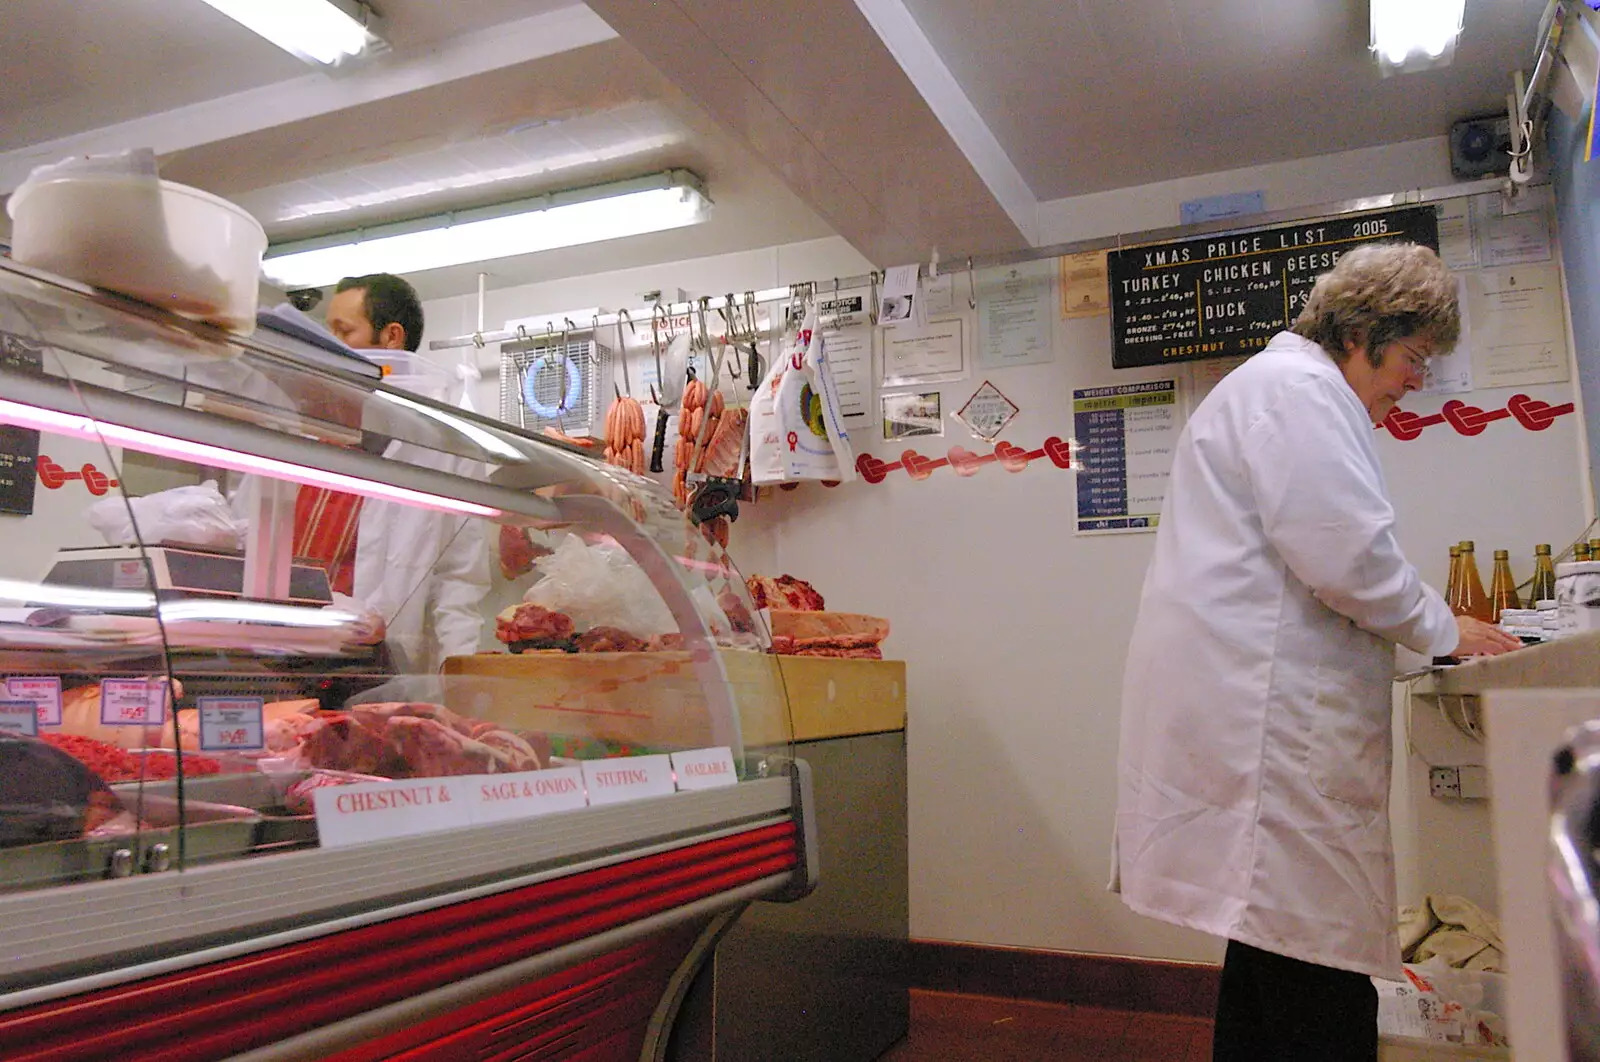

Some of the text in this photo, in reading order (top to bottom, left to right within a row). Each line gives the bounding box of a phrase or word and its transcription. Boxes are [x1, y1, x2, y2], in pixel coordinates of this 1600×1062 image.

[1145, 219, 1388, 267] XMAS PRICE LIST 2005
[1287, 250, 1339, 272] GEESE
[1203, 261, 1271, 283] CHICKEN
[1121, 273, 1180, 293] TURKEY
[1205, 301, 1246, 320] DUCK
[1124, 330, 1194, 344] DRESSING FREE
[1126, 325, 1157, 335] BRONZE
[1163, 341, 1225, 357] CHESTNUT
[1083, 382, 1171, 397] WEIGHT COMPARISON
[684, 761, 729, 776] AVAILABLE
[596, 769, 648, 787] STUFFING
[336, 777, 577, 814] CHESTNUT & SAGE & ONION
